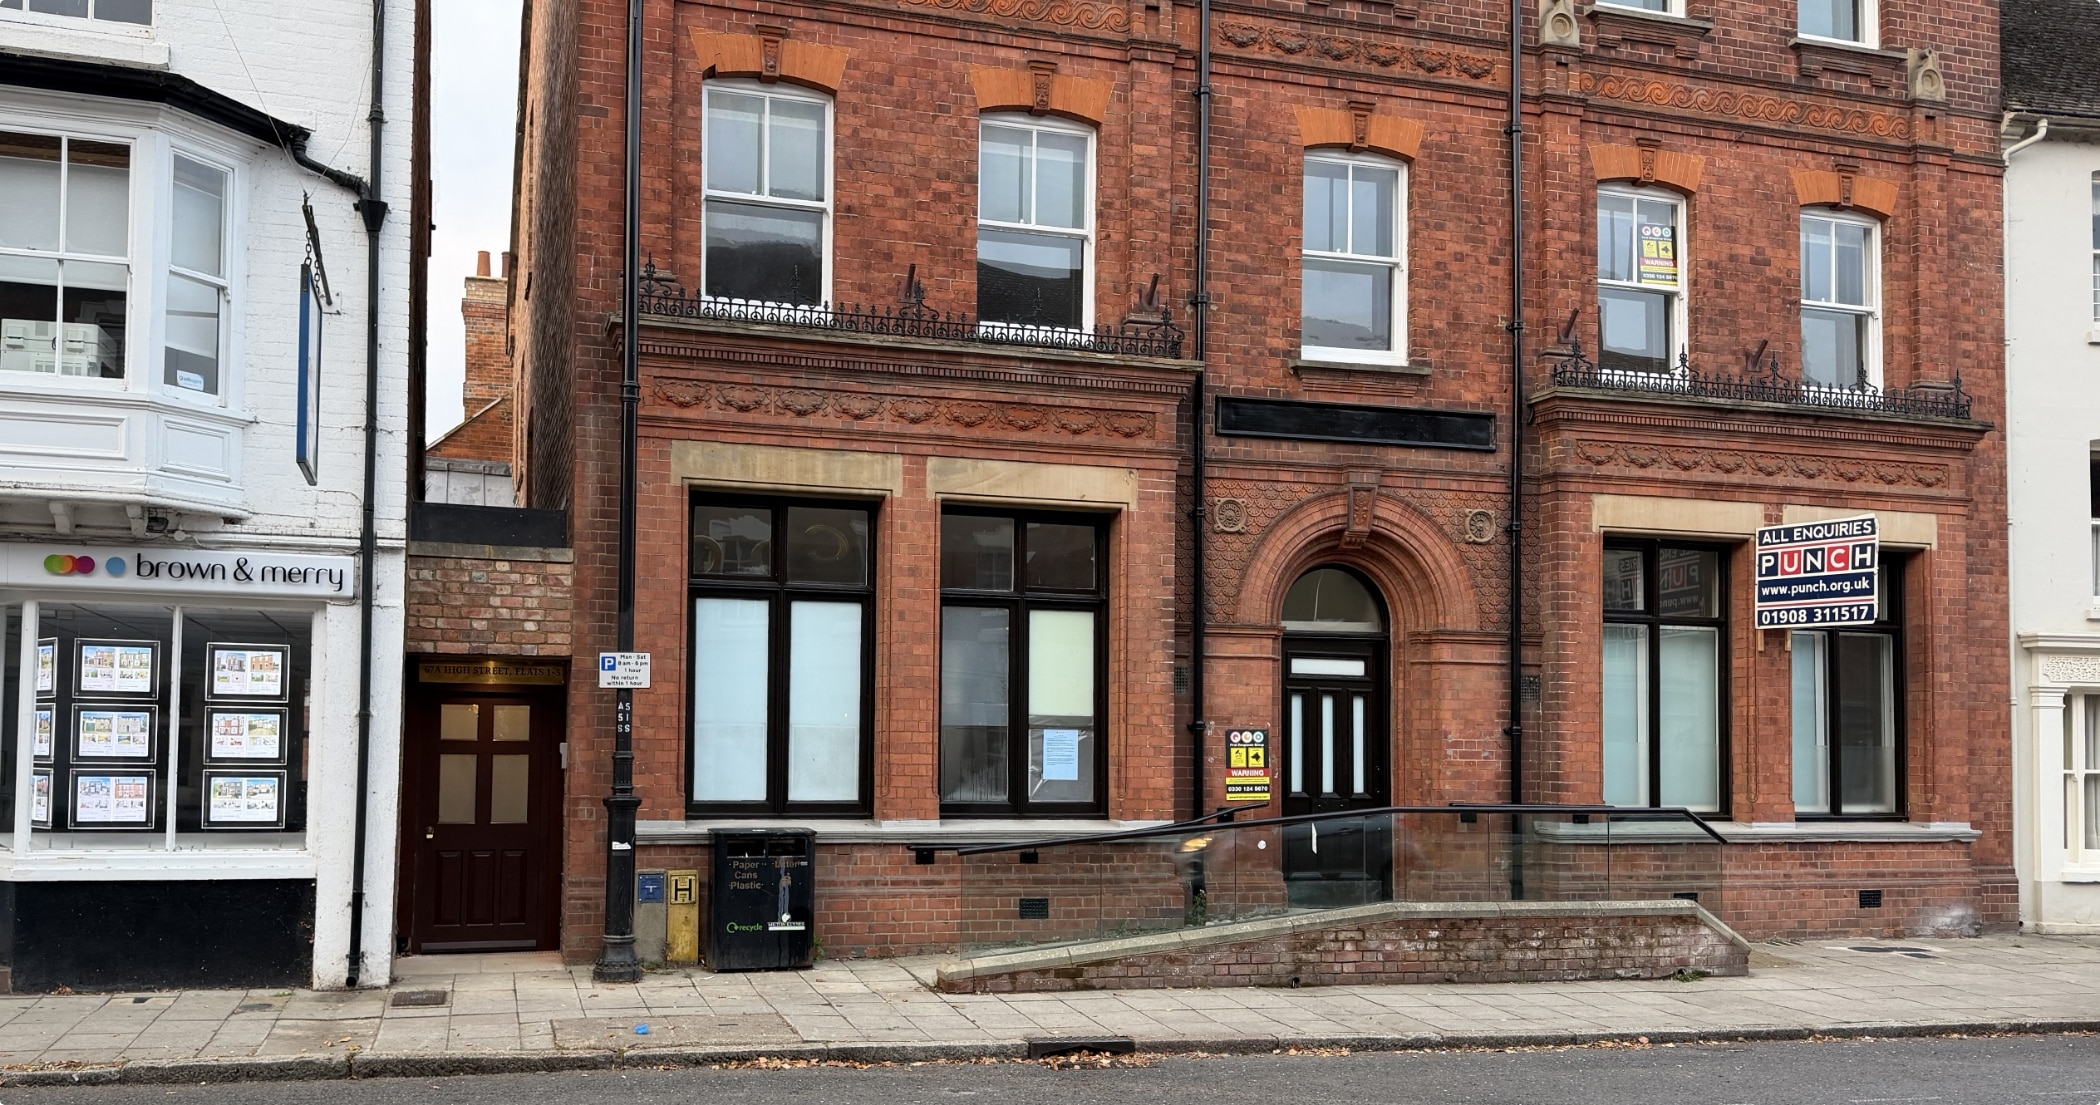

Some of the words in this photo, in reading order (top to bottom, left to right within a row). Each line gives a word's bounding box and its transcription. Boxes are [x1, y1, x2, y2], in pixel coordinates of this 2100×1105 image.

[1762, 531, 1788, 544] ALL
[1794, 520, 1872, 540] ENQUIRIES
[1762, 546, 1872, 574] PUNCH
[136, 552, 225, 580] brown
[234, 557, 254, 582] &
[261, 565, 343, 592] merry
[1762, 576, 1870, 596] www.punch.org.uk
[1762, 610, 1807, 624] 01908
[1813, 606, 1869, 622] 311517
[444, 666, 470, 674] HIGH
[473, 666, 512, 676] STREET,
[515, 667, 544, 676] FLATS
[605, 658, 614, 670] P
[733, 860, 759, 870] Paper
[675, 878, 692, 901] H
[730, 881, 761, 890] Plastic
[739, 923, 762, 932] recycle
